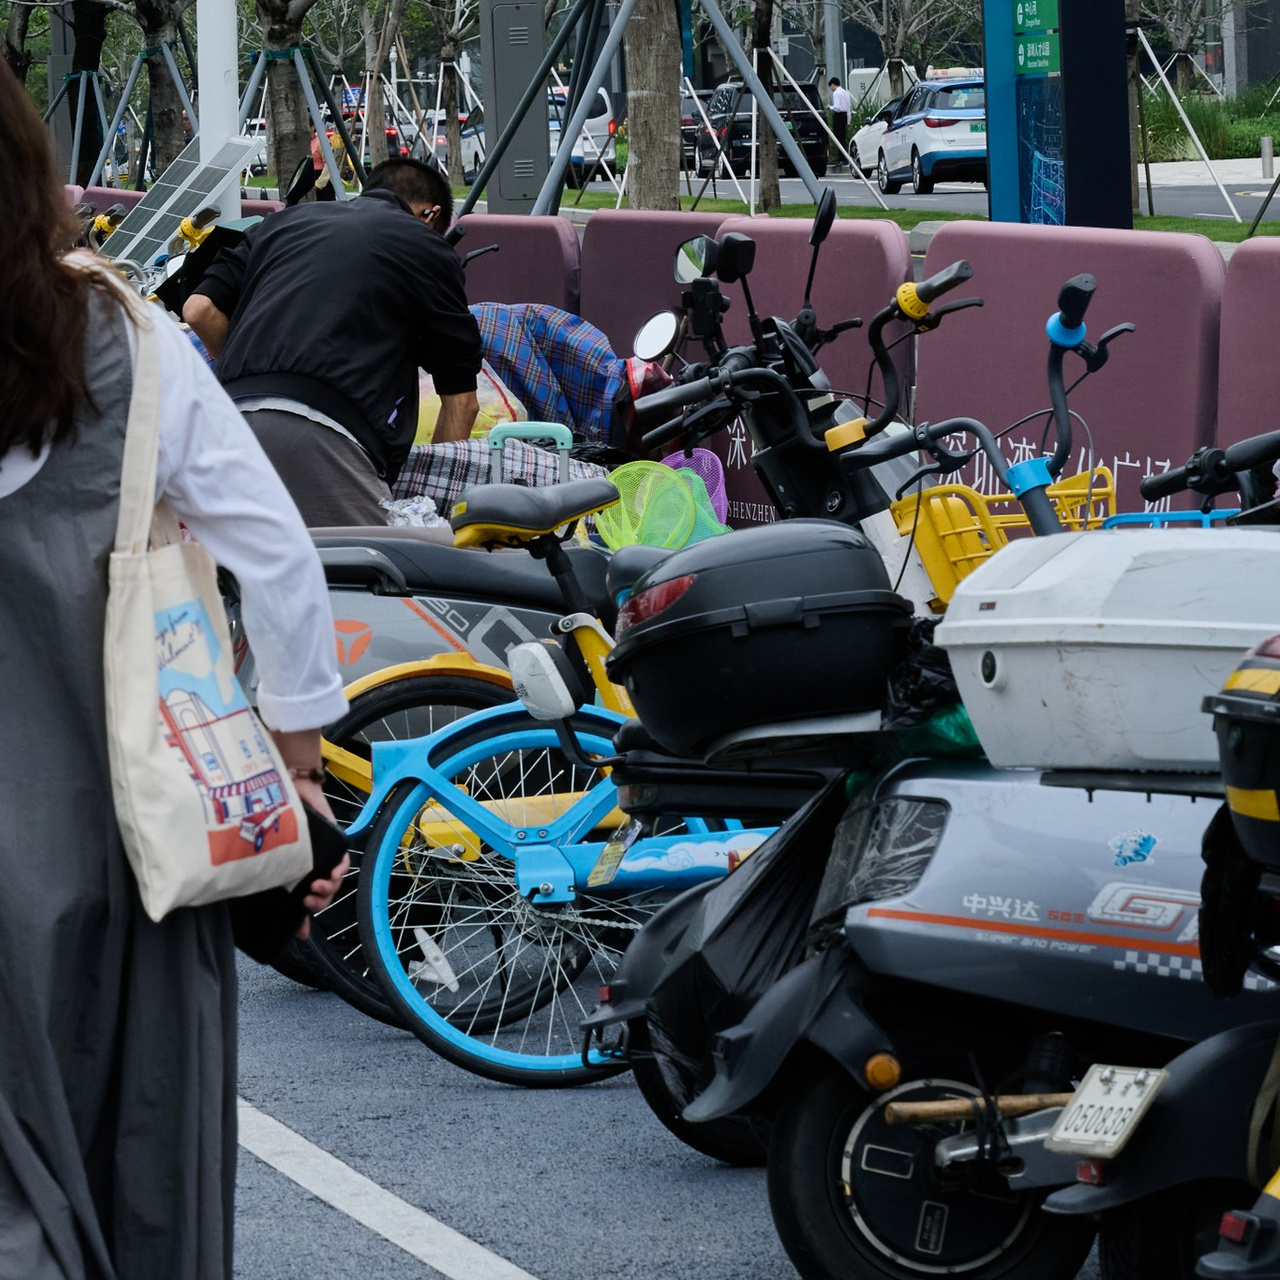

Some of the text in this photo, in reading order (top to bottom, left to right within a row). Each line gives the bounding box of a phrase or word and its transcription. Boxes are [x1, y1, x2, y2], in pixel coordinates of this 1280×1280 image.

[728, 500, 776, 524] SHENZHEN
[963, 893, 1041, 923] 中兴达
